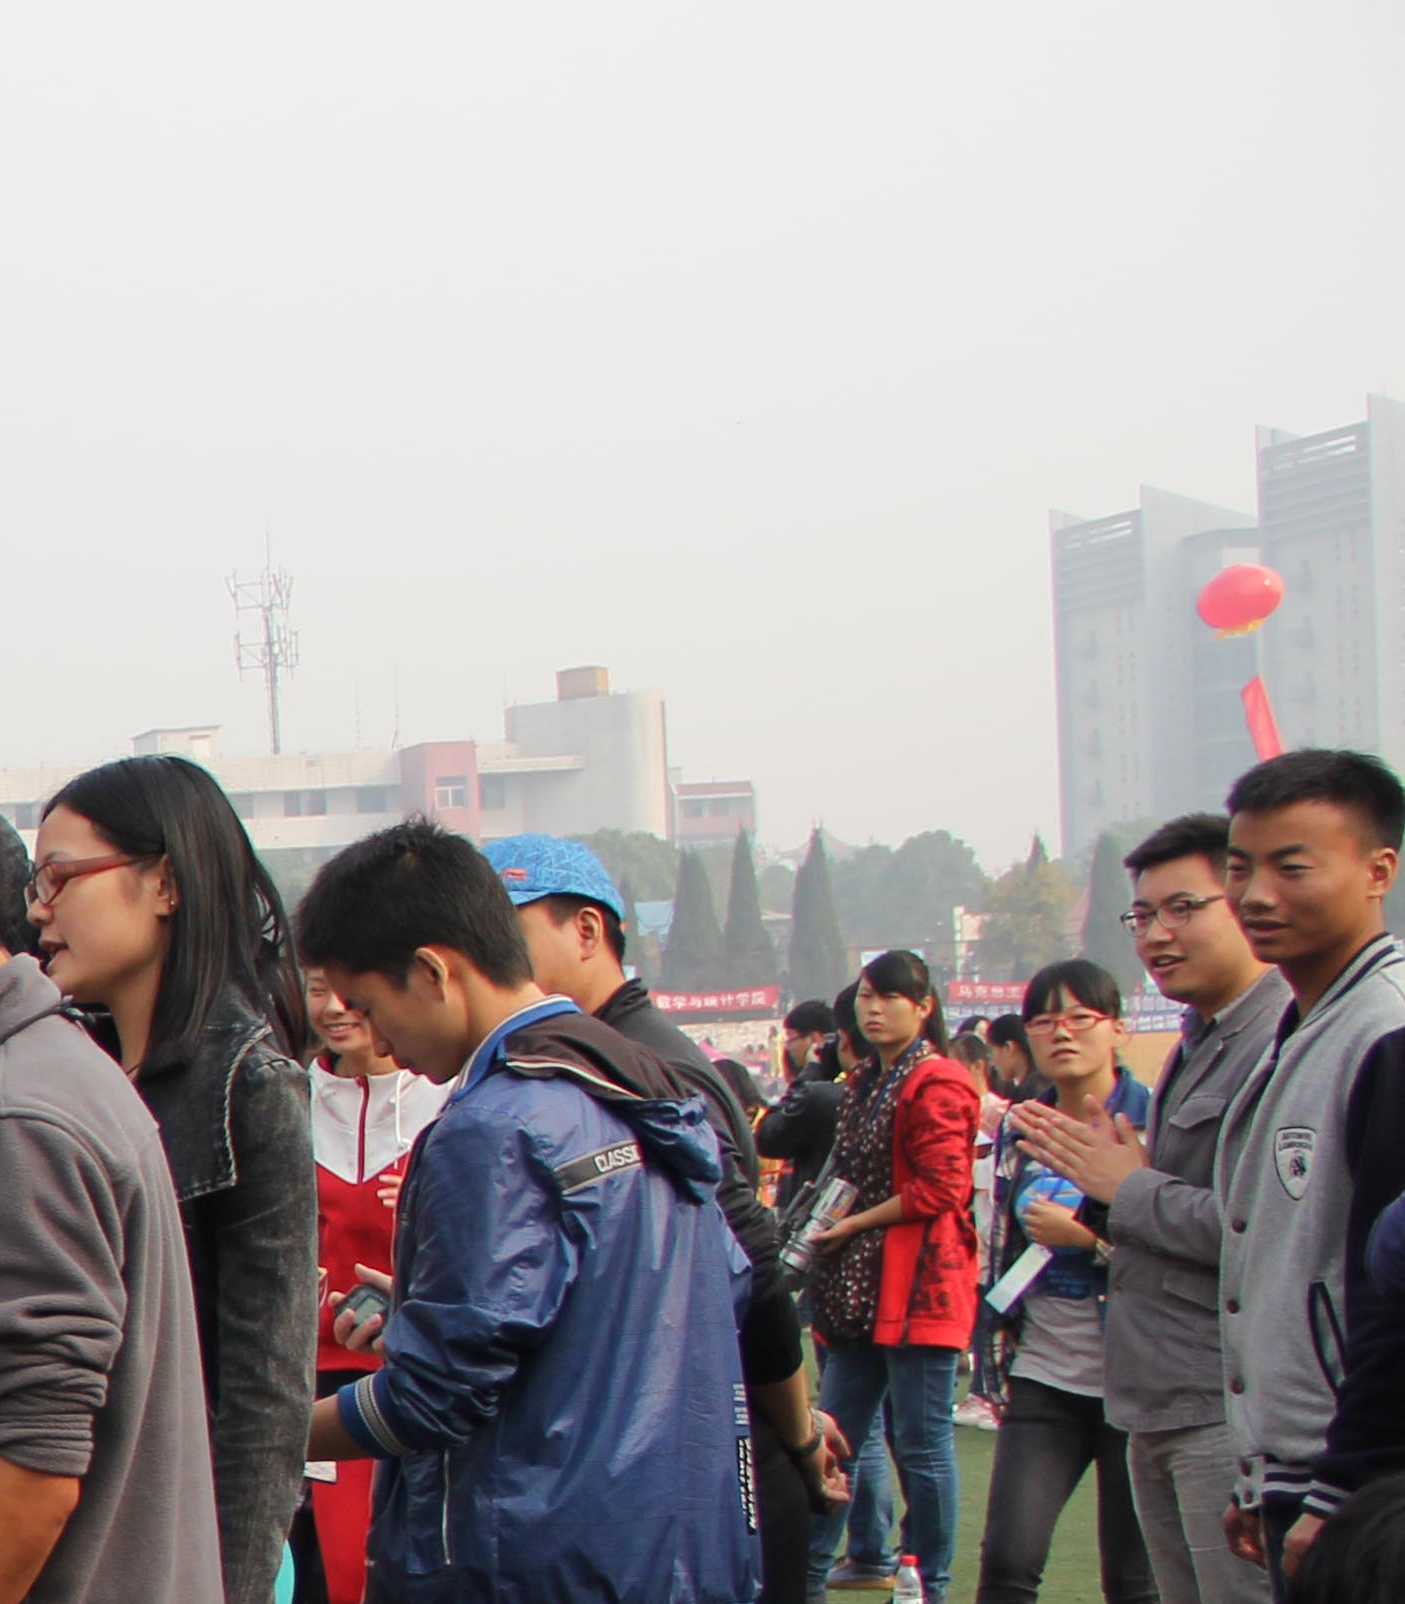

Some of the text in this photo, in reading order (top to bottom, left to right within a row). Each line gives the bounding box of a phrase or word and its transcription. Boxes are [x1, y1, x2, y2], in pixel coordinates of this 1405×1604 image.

[656, 991, 766, 1010] 数学与统计学院
